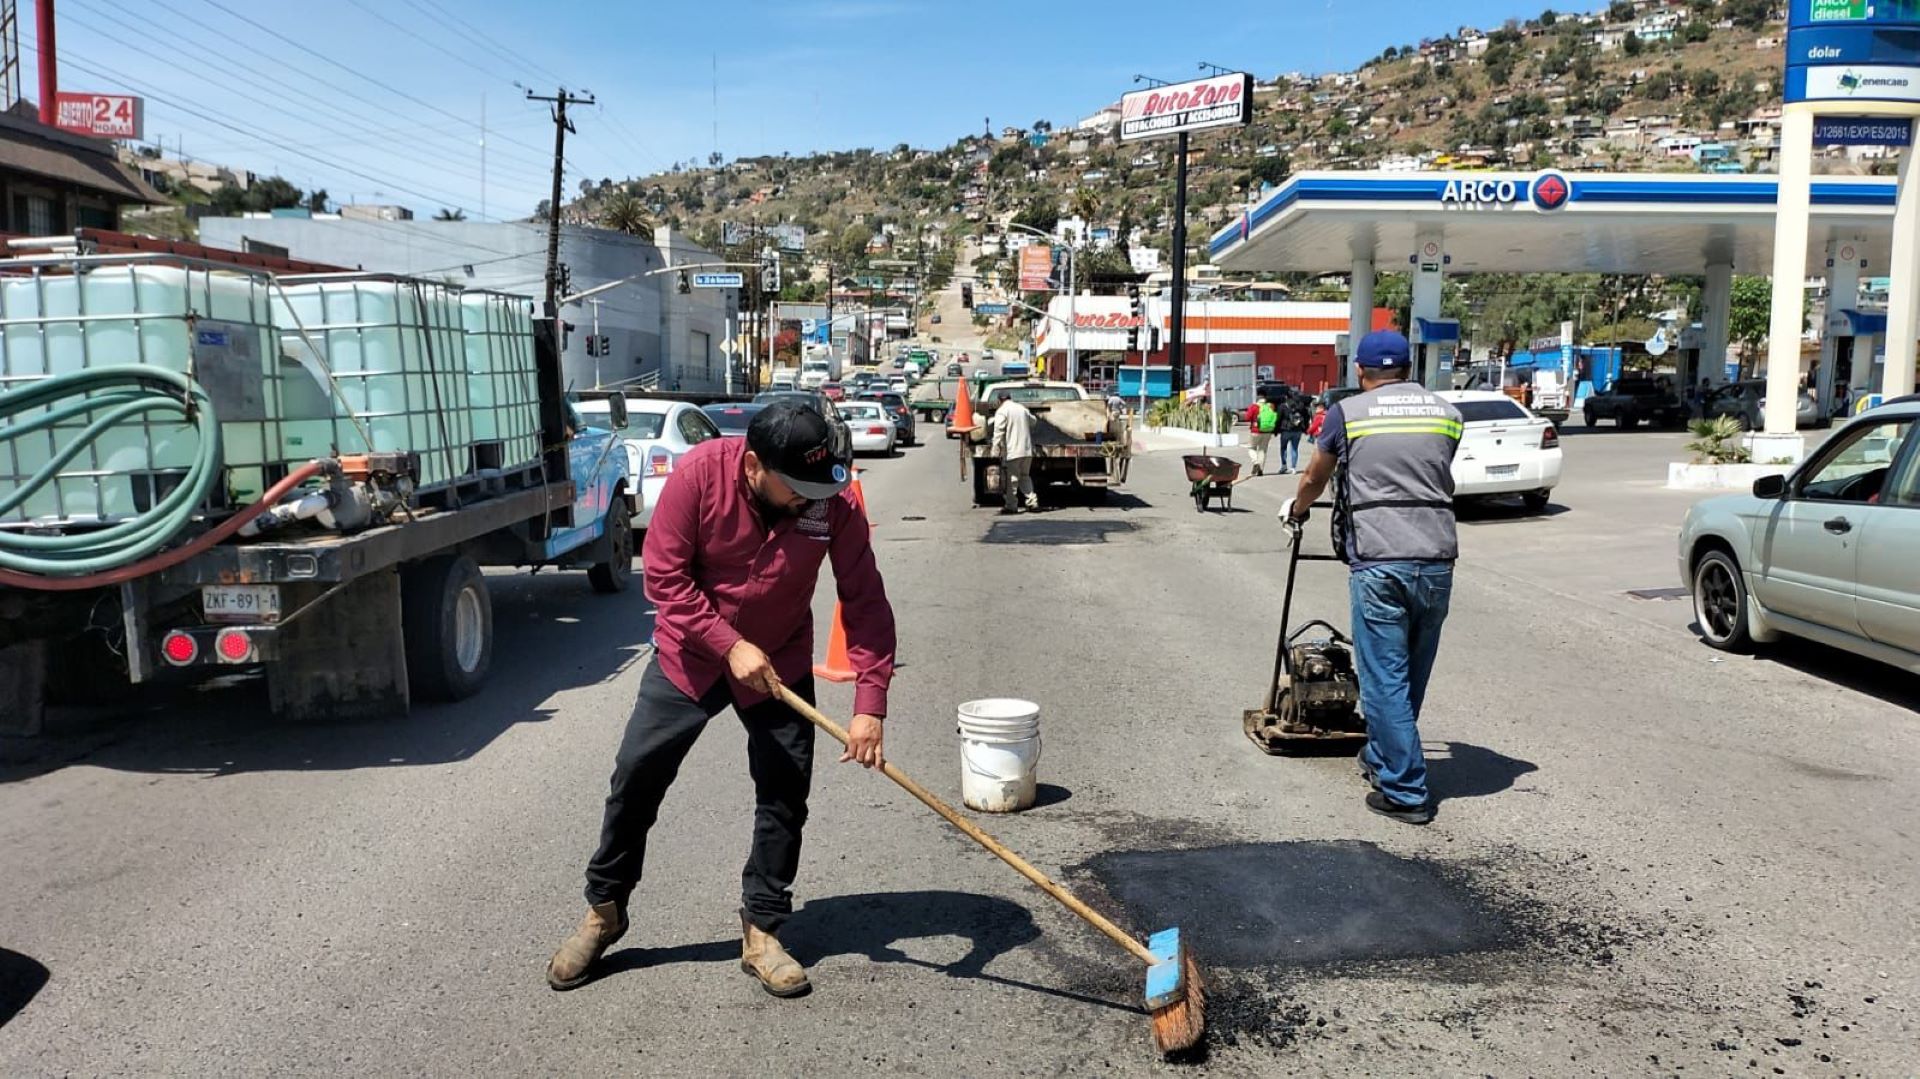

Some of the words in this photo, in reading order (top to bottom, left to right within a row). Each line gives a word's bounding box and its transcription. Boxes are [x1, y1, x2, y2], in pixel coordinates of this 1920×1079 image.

[1814, 6, 1850, 19] diesel
[1808, 46, 1841, 58] dolar
[1142, 82, 1241, 116] AutoZone
[95, 98, 130, 123] 24
[1125, 114, 1177, 134] REFACCIONES
[1178, 112, 1189, 126] Y
[1187, 104, 1239, 123] ACCESORIOS
[95, 123, 131, 134] HORAS
[1442, 181, 1516, 202] ARCO
[1424, 395, 1436, 405] DE
[1368, 405, 1446, 417] INFRAESTRUCTURA
[206, 593, 278, 610] ZKF-891-A
